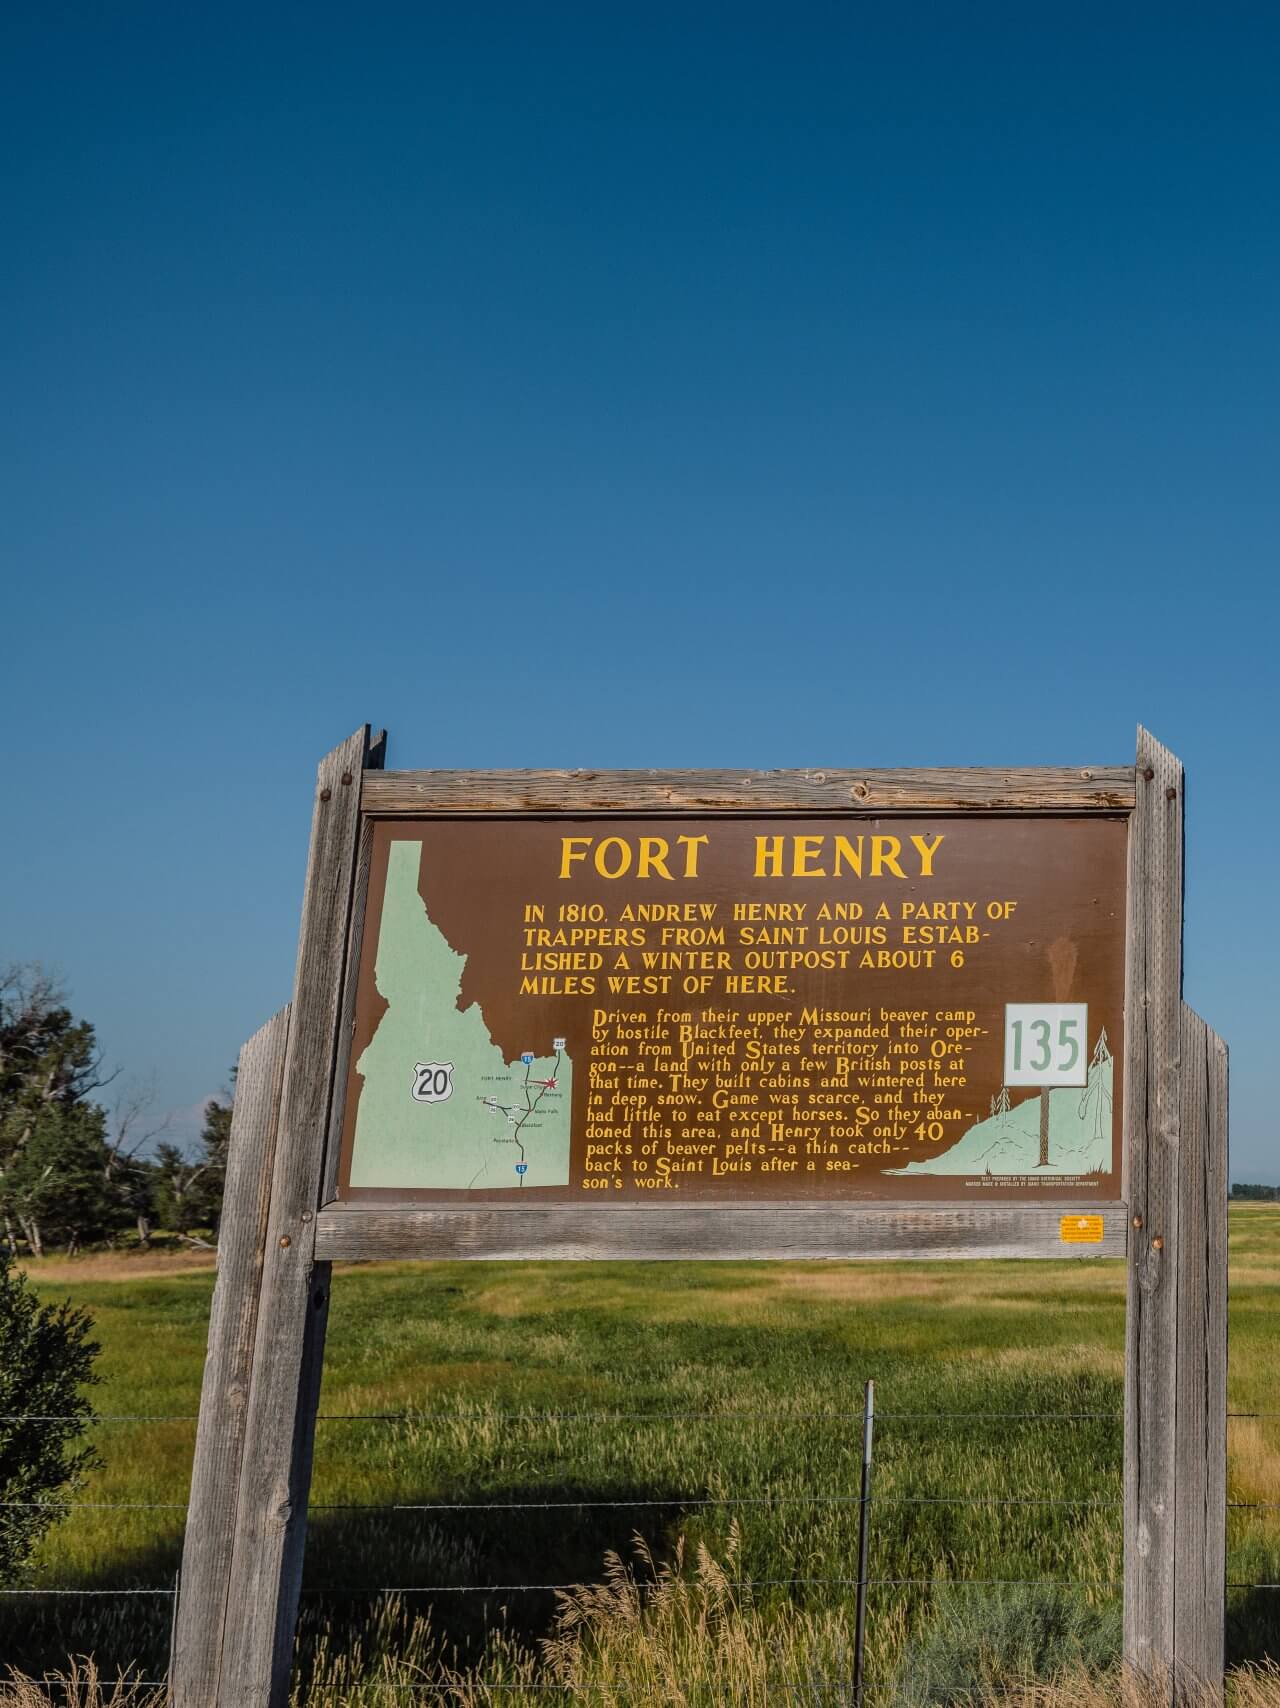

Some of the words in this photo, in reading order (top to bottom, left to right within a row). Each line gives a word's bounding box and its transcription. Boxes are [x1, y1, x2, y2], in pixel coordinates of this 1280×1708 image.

[559, 834, 709, 881] FORT
[753, 834, 944, 879] HENRY
[524, 904, 545, 923] IN
[619, 903, 716, 922] ANDREW
[733, 903, 805, 922] HENRY
[816, 902, 863, 921] AND
[875, 902, 891, 920] A
[901, 901, 977, 921] PARTY
[986, 901, 1015, 920] OF
[524, 927, 646, 948] TRAPPERS
[661, 927, 725, 946] FROM
[739, 926, 808, 946] SAINT
[819, 926, 887, 945] LOUIS
[903, 925, 990, 944] ESTAB-
[521, 952, 603, 971] LISHED
[614, 951, 630, 970] A
[641, 951, 732, 970] WINTER
[744, 950, 850, 970] OUTPOST
[859, 949, 936, 969] ABOUT
[950, 950, 964, 968] 6
[519, 975, 595, 995] MILES
[607, 975, 672, 994] WEST
[683, 975, 714, 994] OF
[726, 975, 795, 994] HERE.
[593, 1009, 647, 1027] Driven
[657, 1008, 692, 1023] from
[701, 1007, 740, 1023] their
[748, 1012, 792, 1026] upper
[799, 1007, 871, 1026] Missouri
[880, 1007, 929, 1022] beaver
[935, 1011, 976, 1025] camp
[592, 1024, 609, 1042] by
[616, 1023, 669, 1040] hostile
[774, 1023, 806, 1042] they
[814, 1023, 889, 1042] expanded
[900, 1023, 937, 1038] their
[946, 1025, 989, 1041] oper-
[590, 1042, 629, 1056] ation
[638, 1041, 672, 1056] from
[682, 1040, 736, 1059] United
[745, 1040, 801, 1060] States
[812, 1042, 879, 1058] territory
[888, 1042, 919, 1054] into
[930, 1039, 972, 1058] Ore-
[1010, 1019, 1079, 1072] 135
[654, 1056, 689, 1072] land
[697, 1059, 731, 1072] with
[740, 1057, 775, 1075] only
[781, 1061, 790, 1071] a
[800, 1056, 828, 1071] few
[836, 1056, 891, 1075] British
[900, 1058, 941, 1075] posts
[949, 1057, 964, 1070] at
[417, 1068, 448, 1096] 20
[589, 1075, 620, 1090] that
[627, 1077, 663, 1089] time.
[668, 1072, 709, 1092] They
[715, 1071, 751, 1088] built
[759, 1074, 810, 1088] cabins
[820, 1073, 849, 1088] and
[857, 1071, 925, 1087] wintered
[934, 1071, 967, 1087] here
[588, 1091, 603, 1105] in
[611, 1090, 647, 1109] deep
[657, 1094, 702, 1105] snow.
[712, 1089, 759, 1109] Game
[769, 1094, 799, 1105] was
[874, 1088, 903, 1104] and
[913, 1089, 945, 1107] they
[587, 1105, 614, 1122] had
[624, 1105, 661, 1122] little
[671, 1109, 687, 1122] to
[697, 1109, 721, 1122] eat
[729, 1109, 783, 1125] except
[792, 1105, 848, 1121] horses.
[855, 1106, 880, 1126] So
[887, 1104, 921, 1124] they
[926, 1109, 973, 1120] aban-
[585, 1122, 632, 1138] doned
[643, 1122, 672, 1138] this
[730, 1122, 761, 1138] and
[771, 1123, 821, 1142] Henry
[829, 1123, 864, 1138] took
[873, 1120, 908, 1140] only
[914, 1121, 944, 1141] 40
[586, 1141, 633, 1158] packs
[641, 1140, 659, 1155] of
[667, 1140, 716, 1155] beaver
[806, 1138, 838, 1154] thin
[848, 1138, 910, 1154] catch--
[585, 1157, 622, 1172] back
[631, 1159, 648, 1172] to
[655, 1156, 704, 1176] Saint
[712, 1157, 752, 1176] Louis
[760, 1156, 799, 1172] after
[806, 1160, 816, 1171] a
[826, 1160, 859, 1171] sea-
[582, 1174, 623, 1189] son's
[634, 1174, 680, 1189] work.
